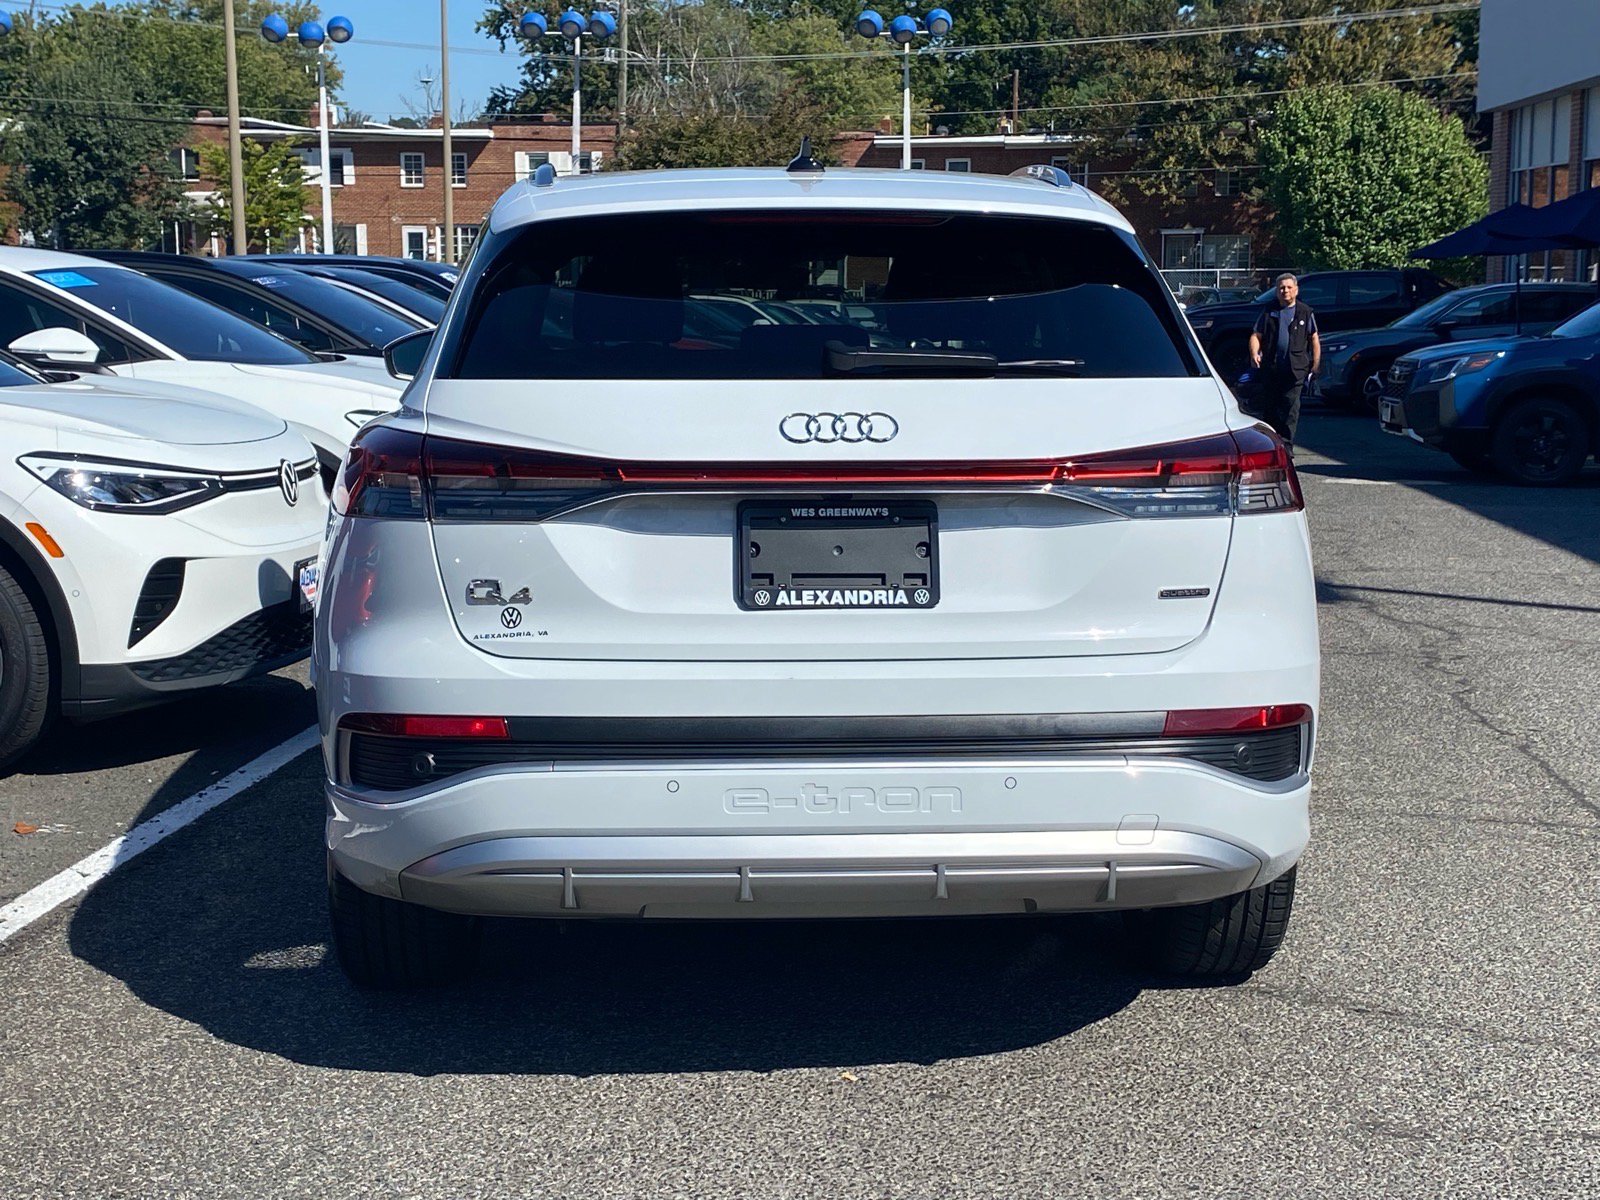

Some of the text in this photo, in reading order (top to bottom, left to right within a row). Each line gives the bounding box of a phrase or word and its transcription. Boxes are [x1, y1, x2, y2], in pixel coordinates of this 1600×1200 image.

[791, 507, 889, 517] WES GREENWAY'S
[465, 579, 533, 606] Q4
[775, 590, 909, 606] ALEXANDRIA
[723, 783, 963, 815] e-tron
